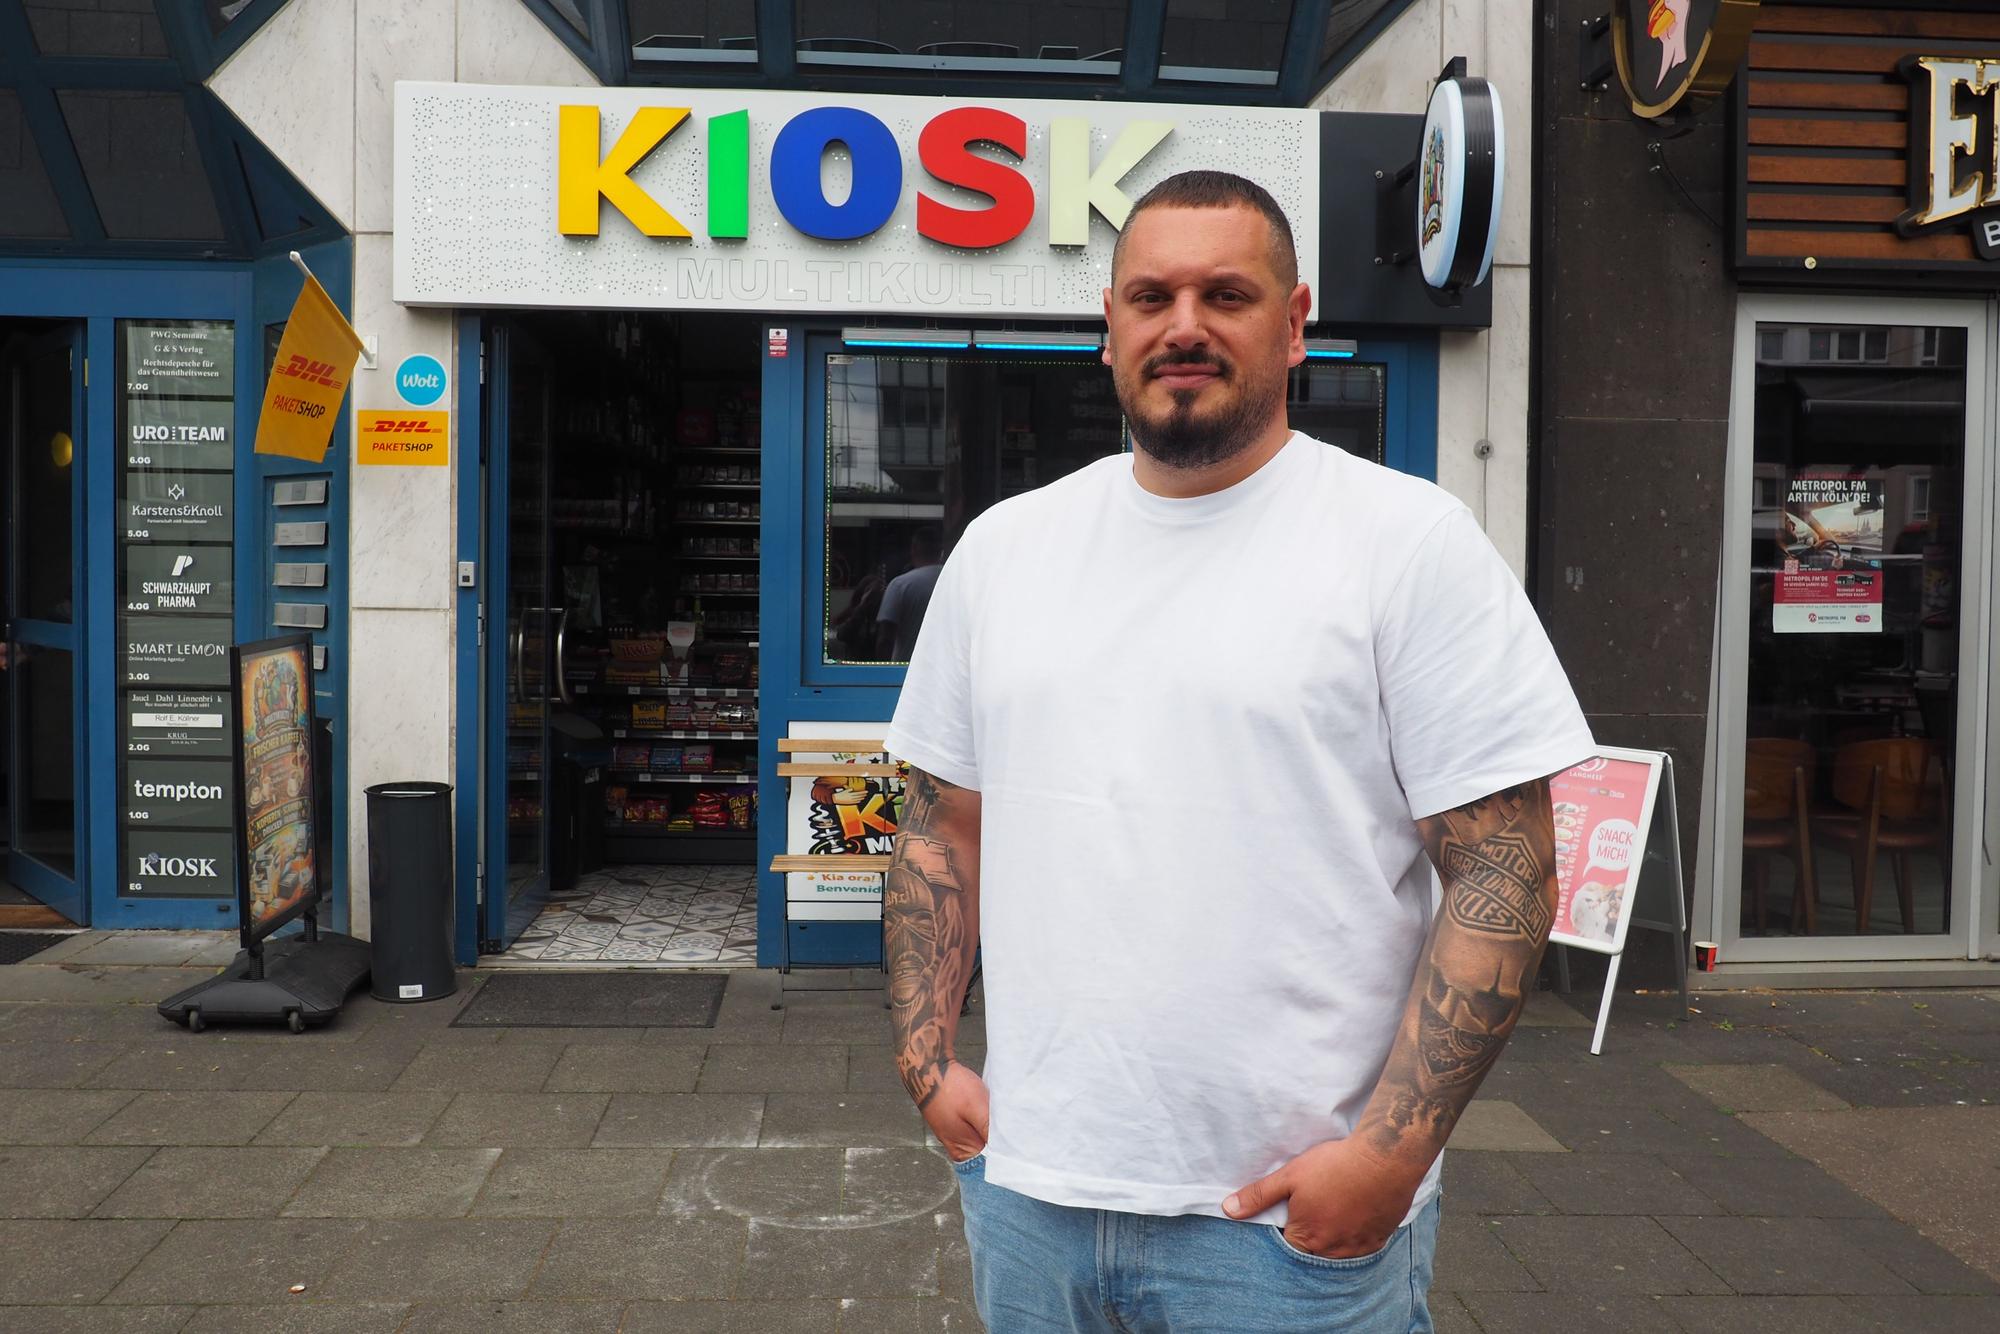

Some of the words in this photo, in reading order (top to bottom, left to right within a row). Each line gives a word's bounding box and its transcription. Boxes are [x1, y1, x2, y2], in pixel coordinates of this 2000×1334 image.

[559, 104, 1175, 247] KIOSK
[676, 257, 1047, 307] MULTIKULTI
[180, 346, 204, 354] Verlag
[137, 368, 151, 376] das
[152, 369, 219, 377] Gesundheitswesen
[285, 354, 336, 386] DHL
[403, 374, 439, 388] Wolt
[272, 394, 326, 419] PAKETSHOP
[133, 426, 169, 440] URO
[178, 426, 225, 441] TEAM
[374, 420, 432, 433] DHL
[372, 442, 434, 452] PAKETSHOP
[1791, 480, 1848, 491] METROPOL
[1850, 481, 1867, 491] FM
[1787, 492, 1820, 502] ARTIK
[132, 505, 223, 516] Karstens&Knoll
[142, 582, 211, 594] SCHWARZHAUPT
[157, 596, 196, 608] PHARMA
[128, 643, 173, 654] SMART
[177, 644, 225, 657] LEMON
[128, 743, 150, 751] 2.OG
[134, 780, 222, 801] tempton
[1597, 828, 1633, 845] SNACK
[139, 857, 217, 877] KIOSK
[1479, 841, 1537, 886] MOTOR
[822, 873, 844, 881] Kia
[816, 885, 882, 894] Benvenid
[1450, 850, 1488, 883] HARLEY
[1482, 873, 1541, 930] DAVIDSON
[1454, 884, 1513, 922] CYCLES
